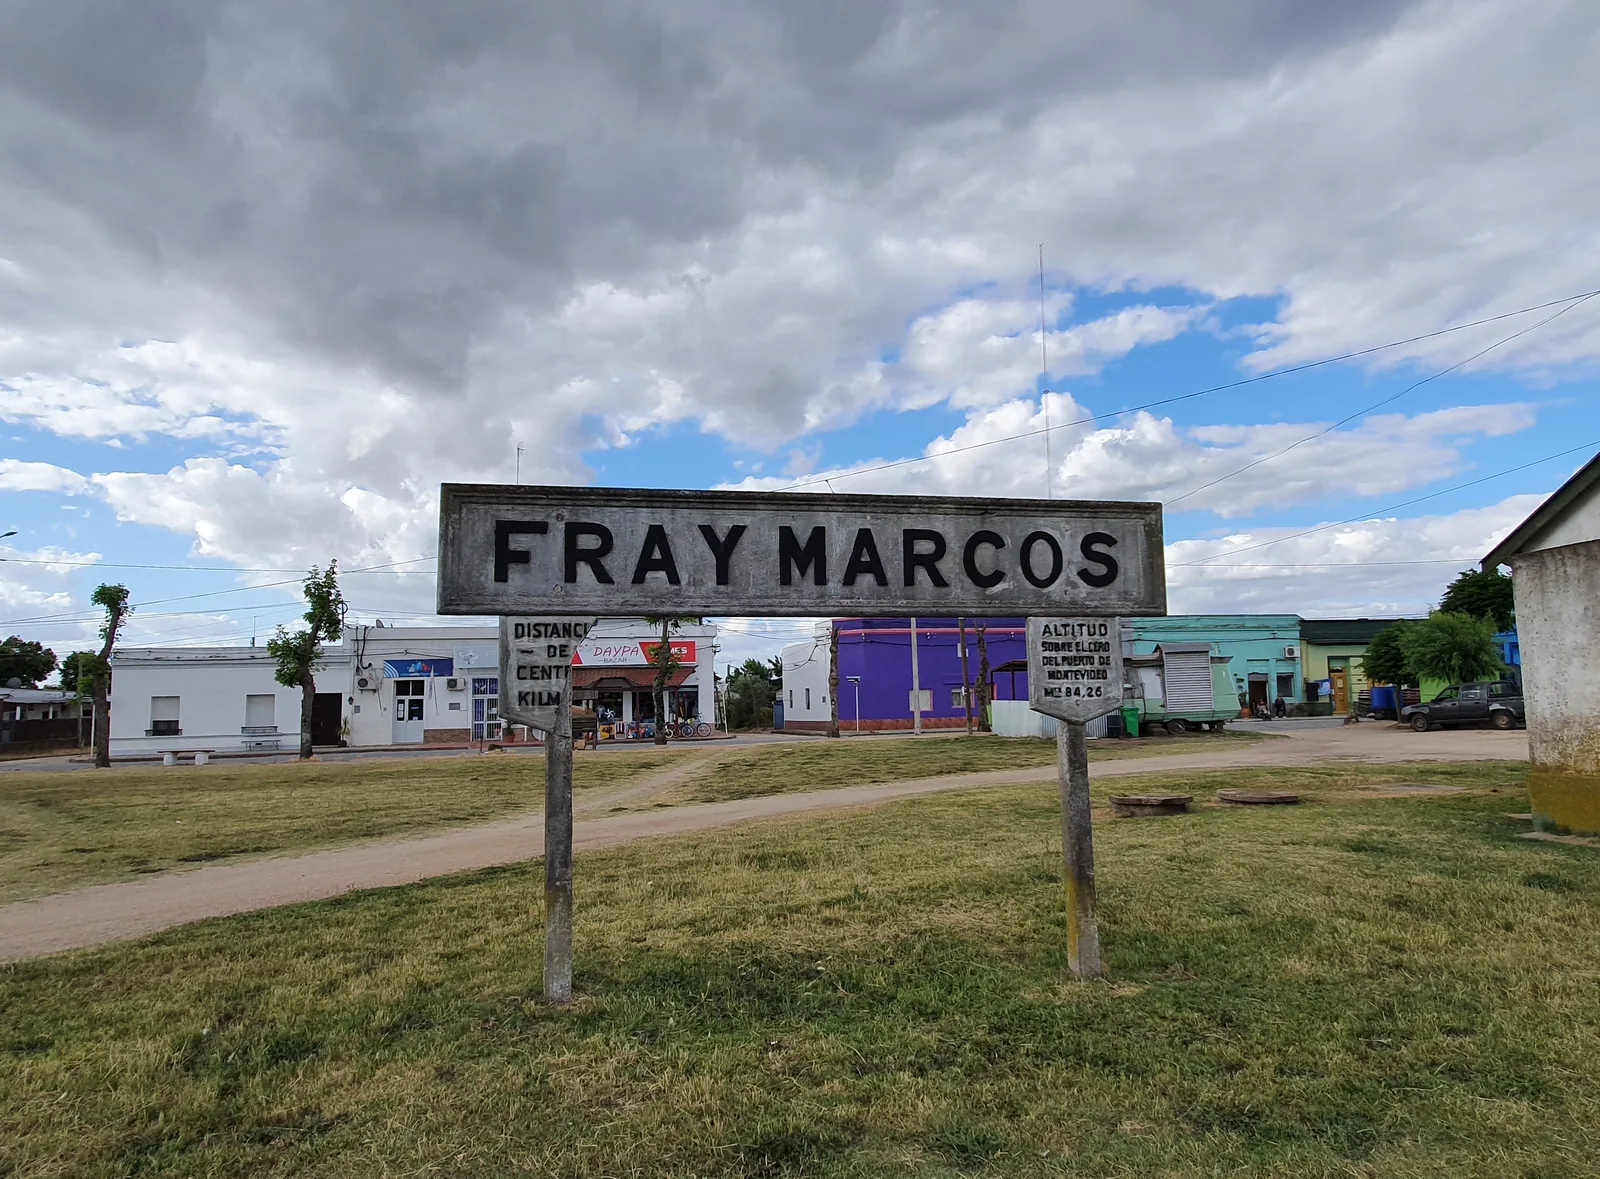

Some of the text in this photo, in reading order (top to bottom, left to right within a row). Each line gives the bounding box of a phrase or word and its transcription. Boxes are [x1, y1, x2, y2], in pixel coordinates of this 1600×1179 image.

[494, 519, 1119, 589] FRAY MARCOS
[1042, 623, 1108, 637] ALTITUD
[547, 644, 569, 658] DE
[593, 645, 639, 657] DAYPA
[1041, 641, 1073, 652] SOBRE
[1075, 641, 1087, 652] EL
[1042, 655, 1111, 666] DEL PUERTO DE
[1047, 669, 1108, 680] MONTEVIDEO
[1065, 686, 1103, 698] 84,26
